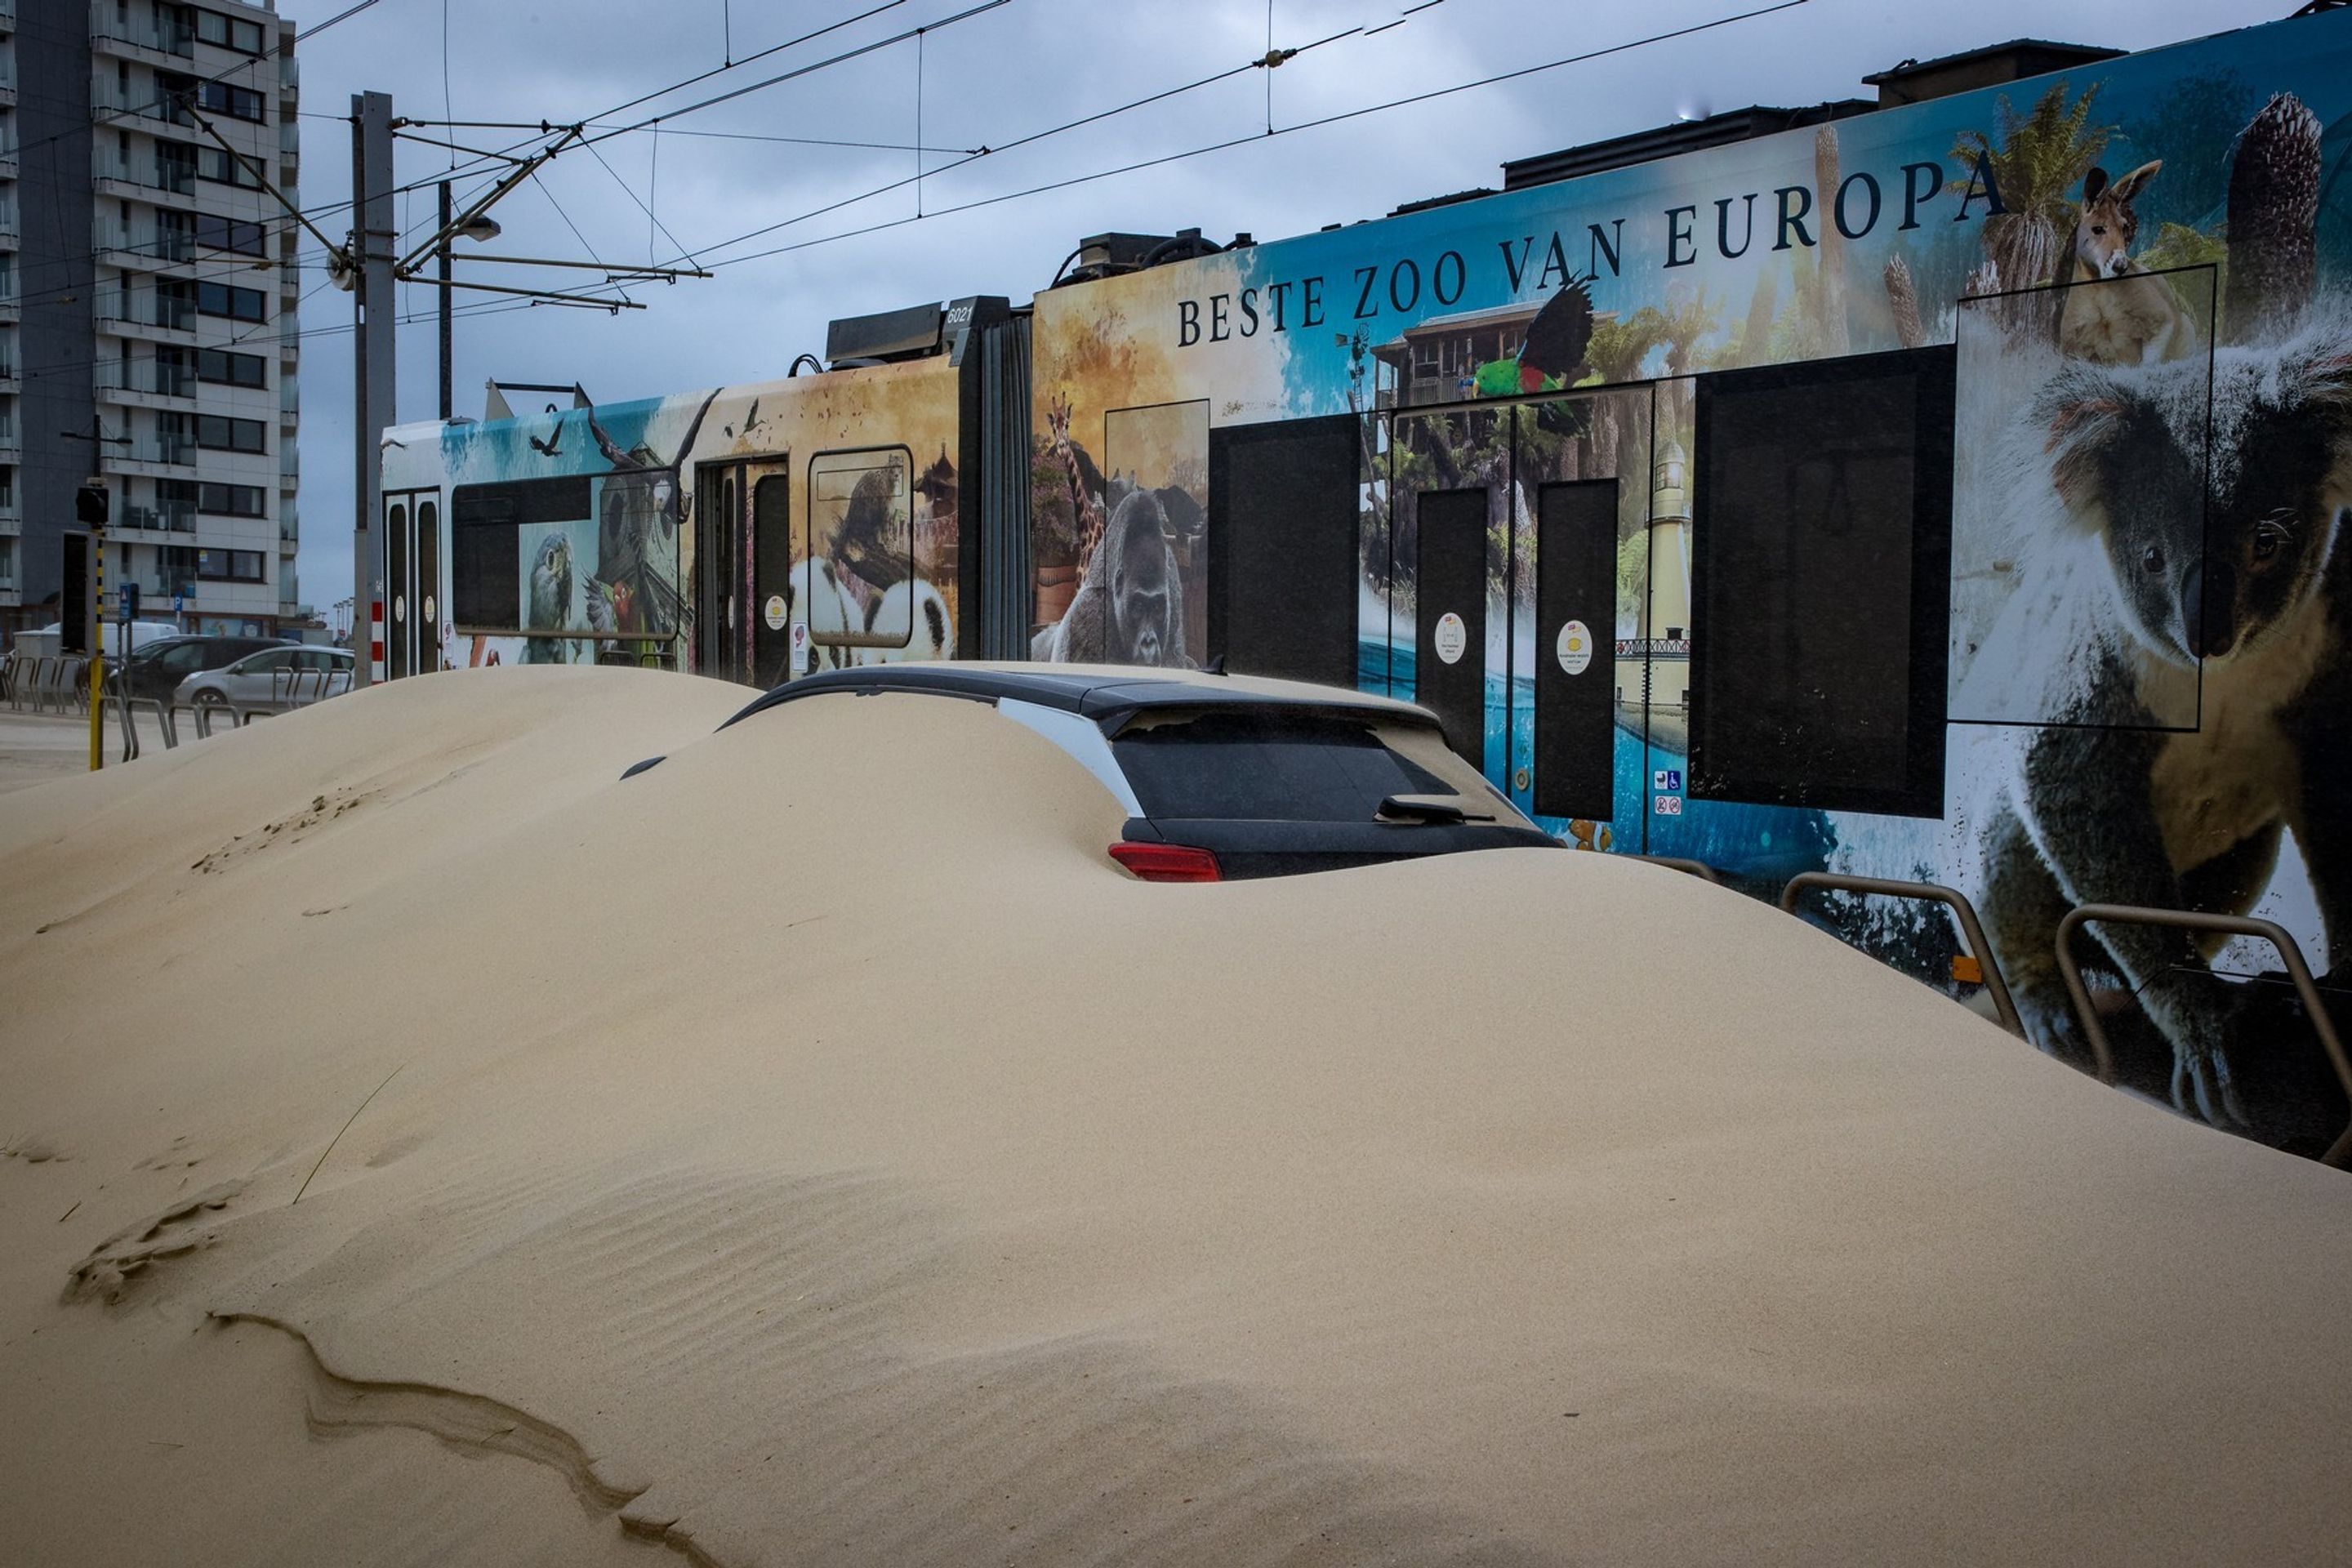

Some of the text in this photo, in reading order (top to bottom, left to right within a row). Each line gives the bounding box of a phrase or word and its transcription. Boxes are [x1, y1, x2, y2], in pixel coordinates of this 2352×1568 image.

[1177, 149, 2009, 348] BESTE ZOO VAN EUROPA
[947, 305, 973, 323] 6021
[175, 596, 181, 609] P
